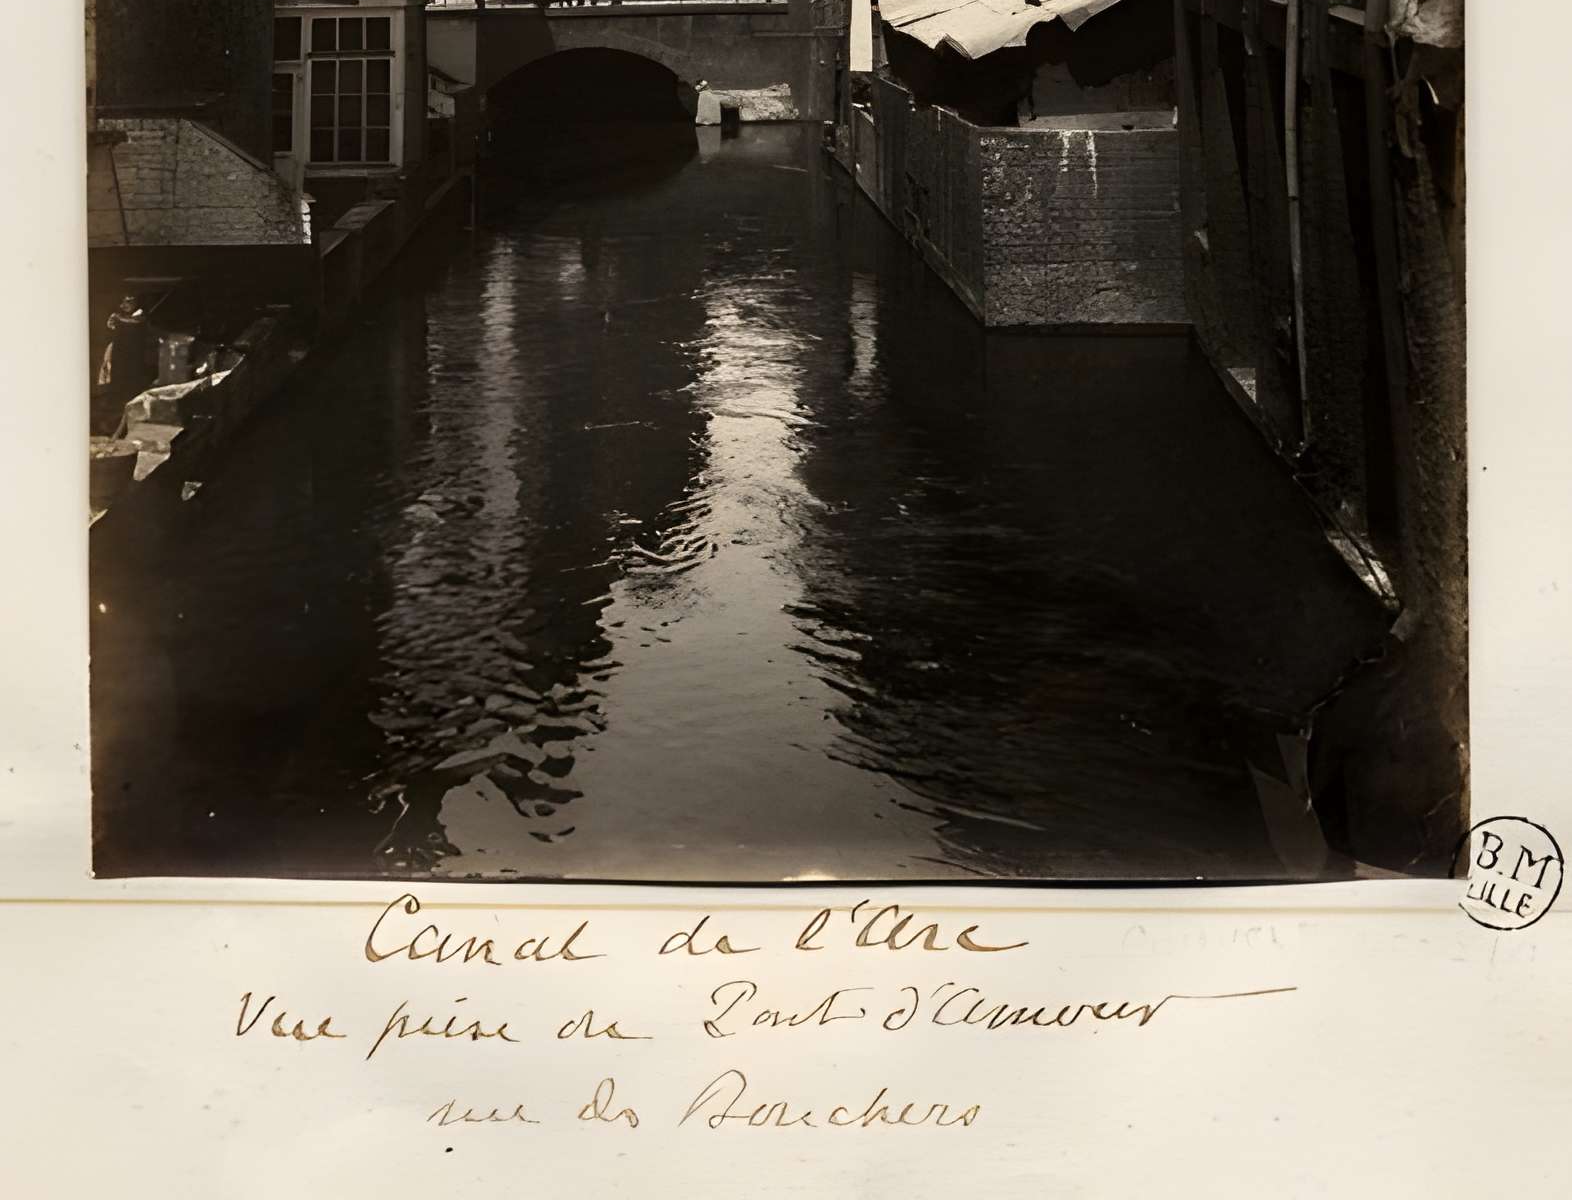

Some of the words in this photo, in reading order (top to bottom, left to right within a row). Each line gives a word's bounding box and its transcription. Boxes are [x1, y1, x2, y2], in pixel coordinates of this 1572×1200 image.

[365, 893, 607, 966] Canal
[659, 915, 760, 955] de
[1466, 880, 1533, 918] LILLE
[236, 992, 346, 1041] Vue
[366, 997, 520, 1060] prise
[704, 980, 874, 1038] Pont
[427, 1099, 540, 1126] rue
[678, 1069, 978, 1130] Bouchers
